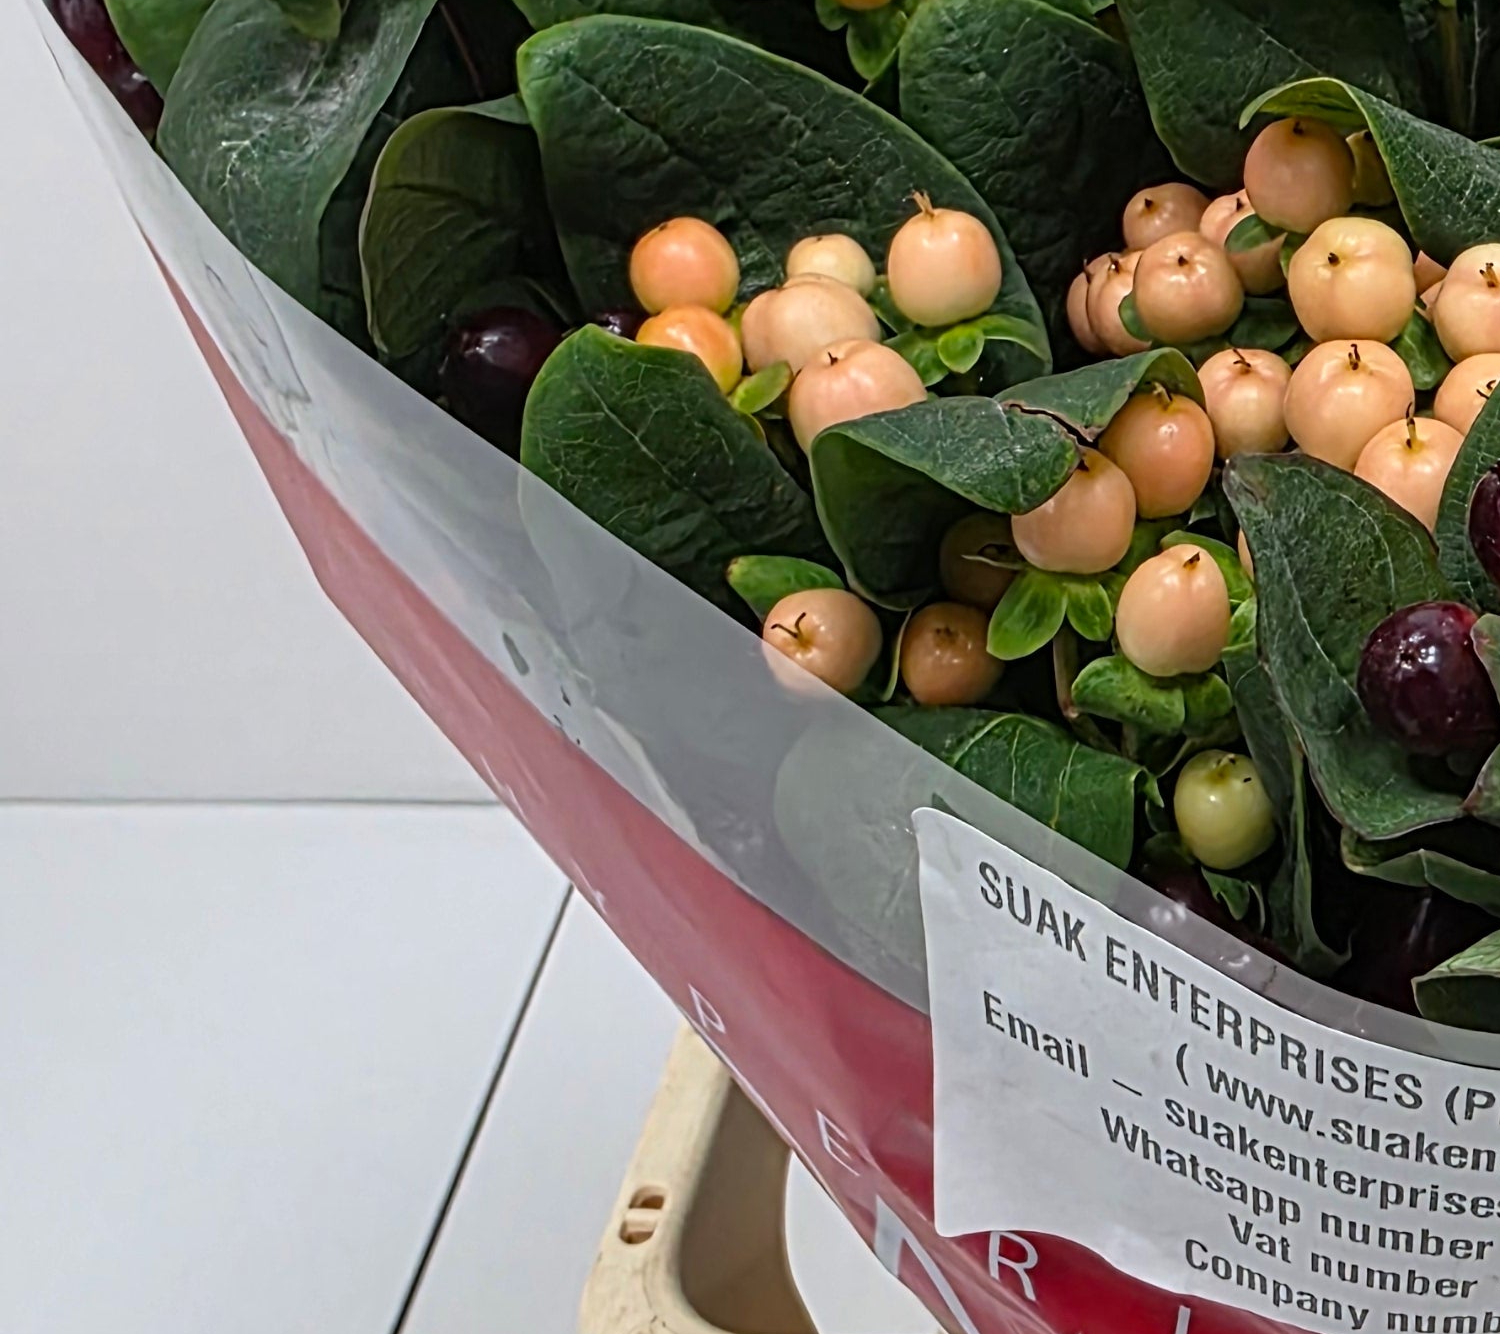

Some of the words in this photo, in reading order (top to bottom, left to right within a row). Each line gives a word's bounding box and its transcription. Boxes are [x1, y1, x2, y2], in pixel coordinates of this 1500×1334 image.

[978, 861, 1087, 962] SUAK
[1106, 935, 1424, 1110] ENTERPRISES
[983, 990, 1089, 1078] Email
[1100, 1106, 1301, 1225] Whatsapp
[1321, 1211, 1494, 1261] number
[1184, 1238, 1369, 1330] Company
[1228, 1213, 1292, 1264] Vat
[1311, 1252, 1479, 1299] number
